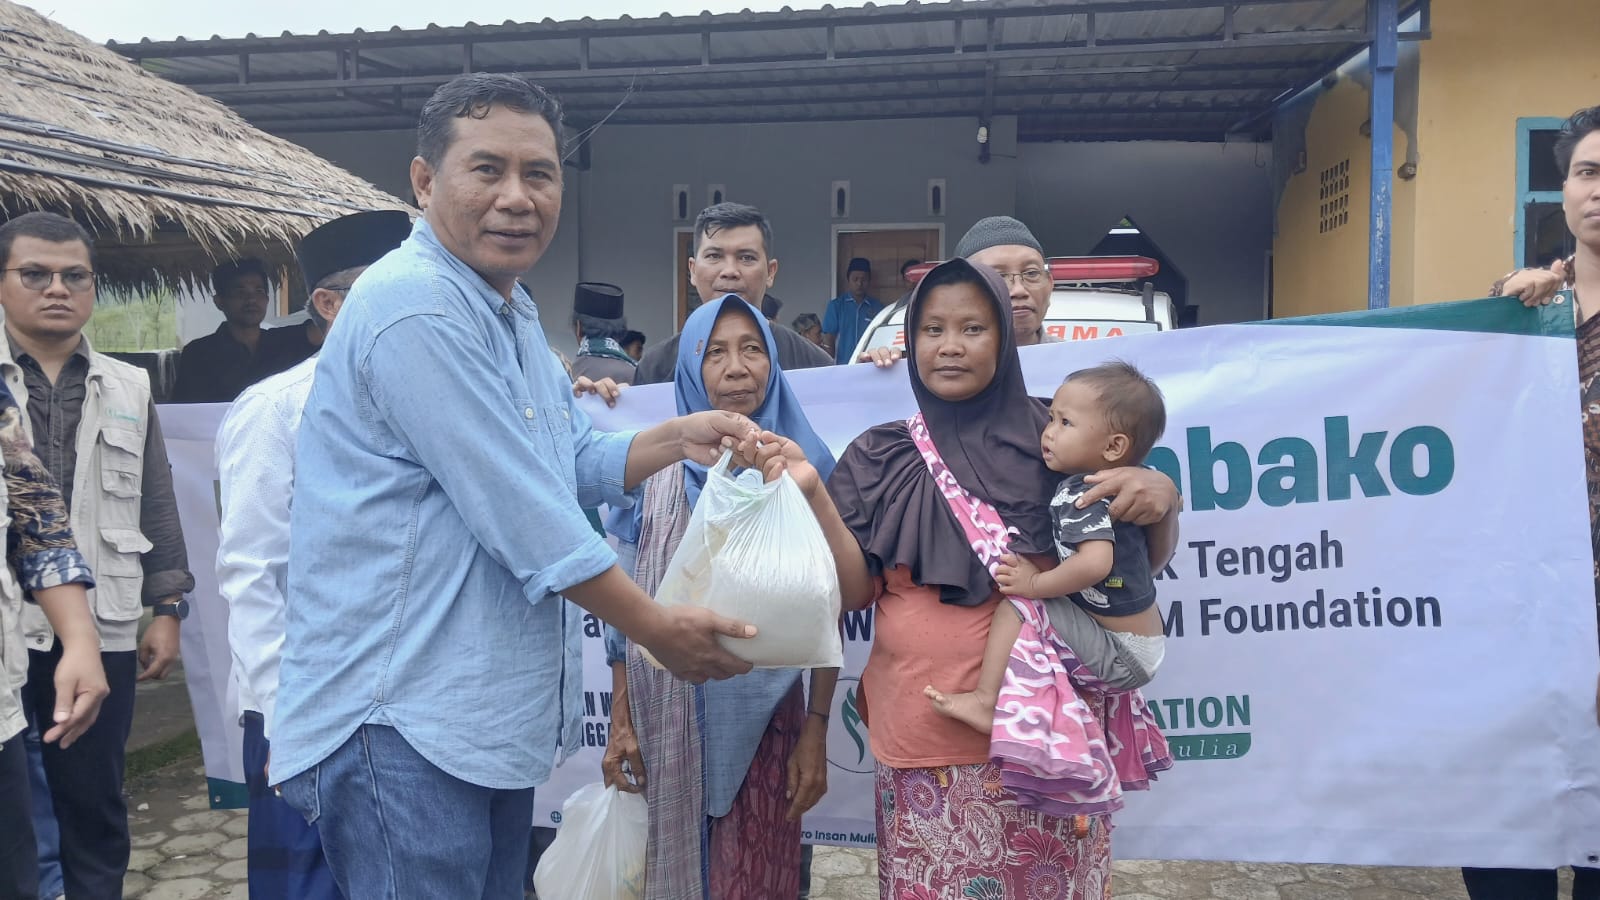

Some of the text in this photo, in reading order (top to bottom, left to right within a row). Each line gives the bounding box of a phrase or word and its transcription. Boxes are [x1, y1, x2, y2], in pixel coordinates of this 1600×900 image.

[1188, 530, 1343, 583] Tengah
[1200, 587, 1442, 636] Foundation
[1169, 739, 1238, 757] ulia
[815, 830, 847, 842] Insan
